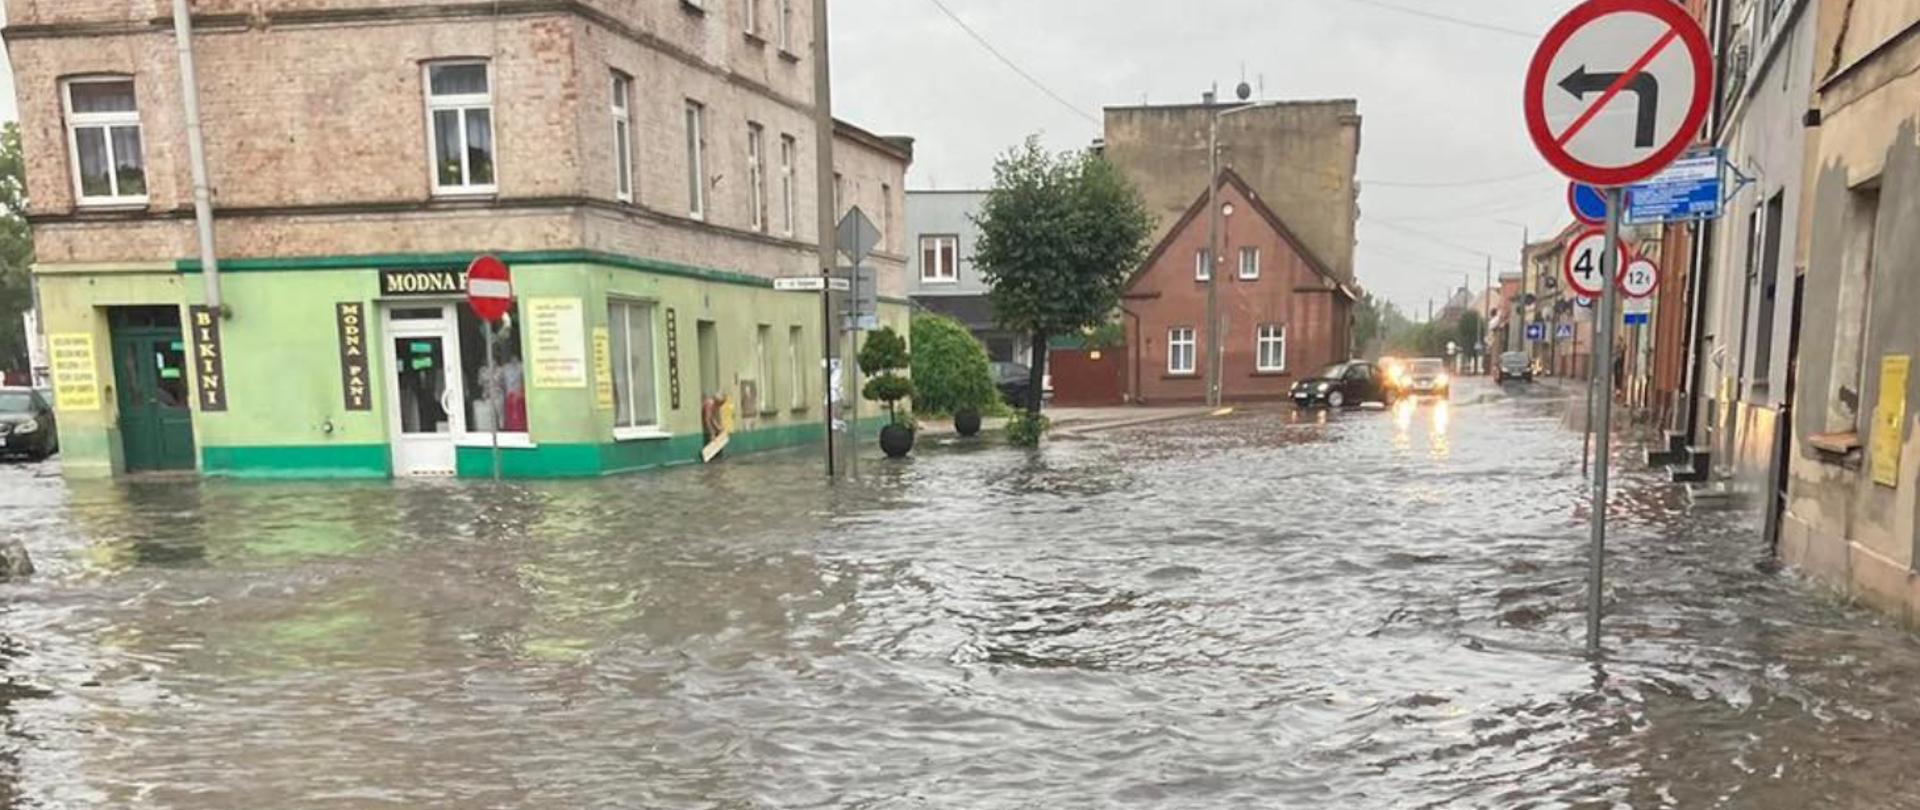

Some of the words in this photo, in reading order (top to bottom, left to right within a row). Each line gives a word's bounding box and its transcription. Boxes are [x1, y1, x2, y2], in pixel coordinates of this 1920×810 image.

[386, 272, 455, 292] MODNA
[341, 305, 361, 355] MODNA
[197, 311, 218, 405] BIKINI
[348, 366, 365, 406] PANI
